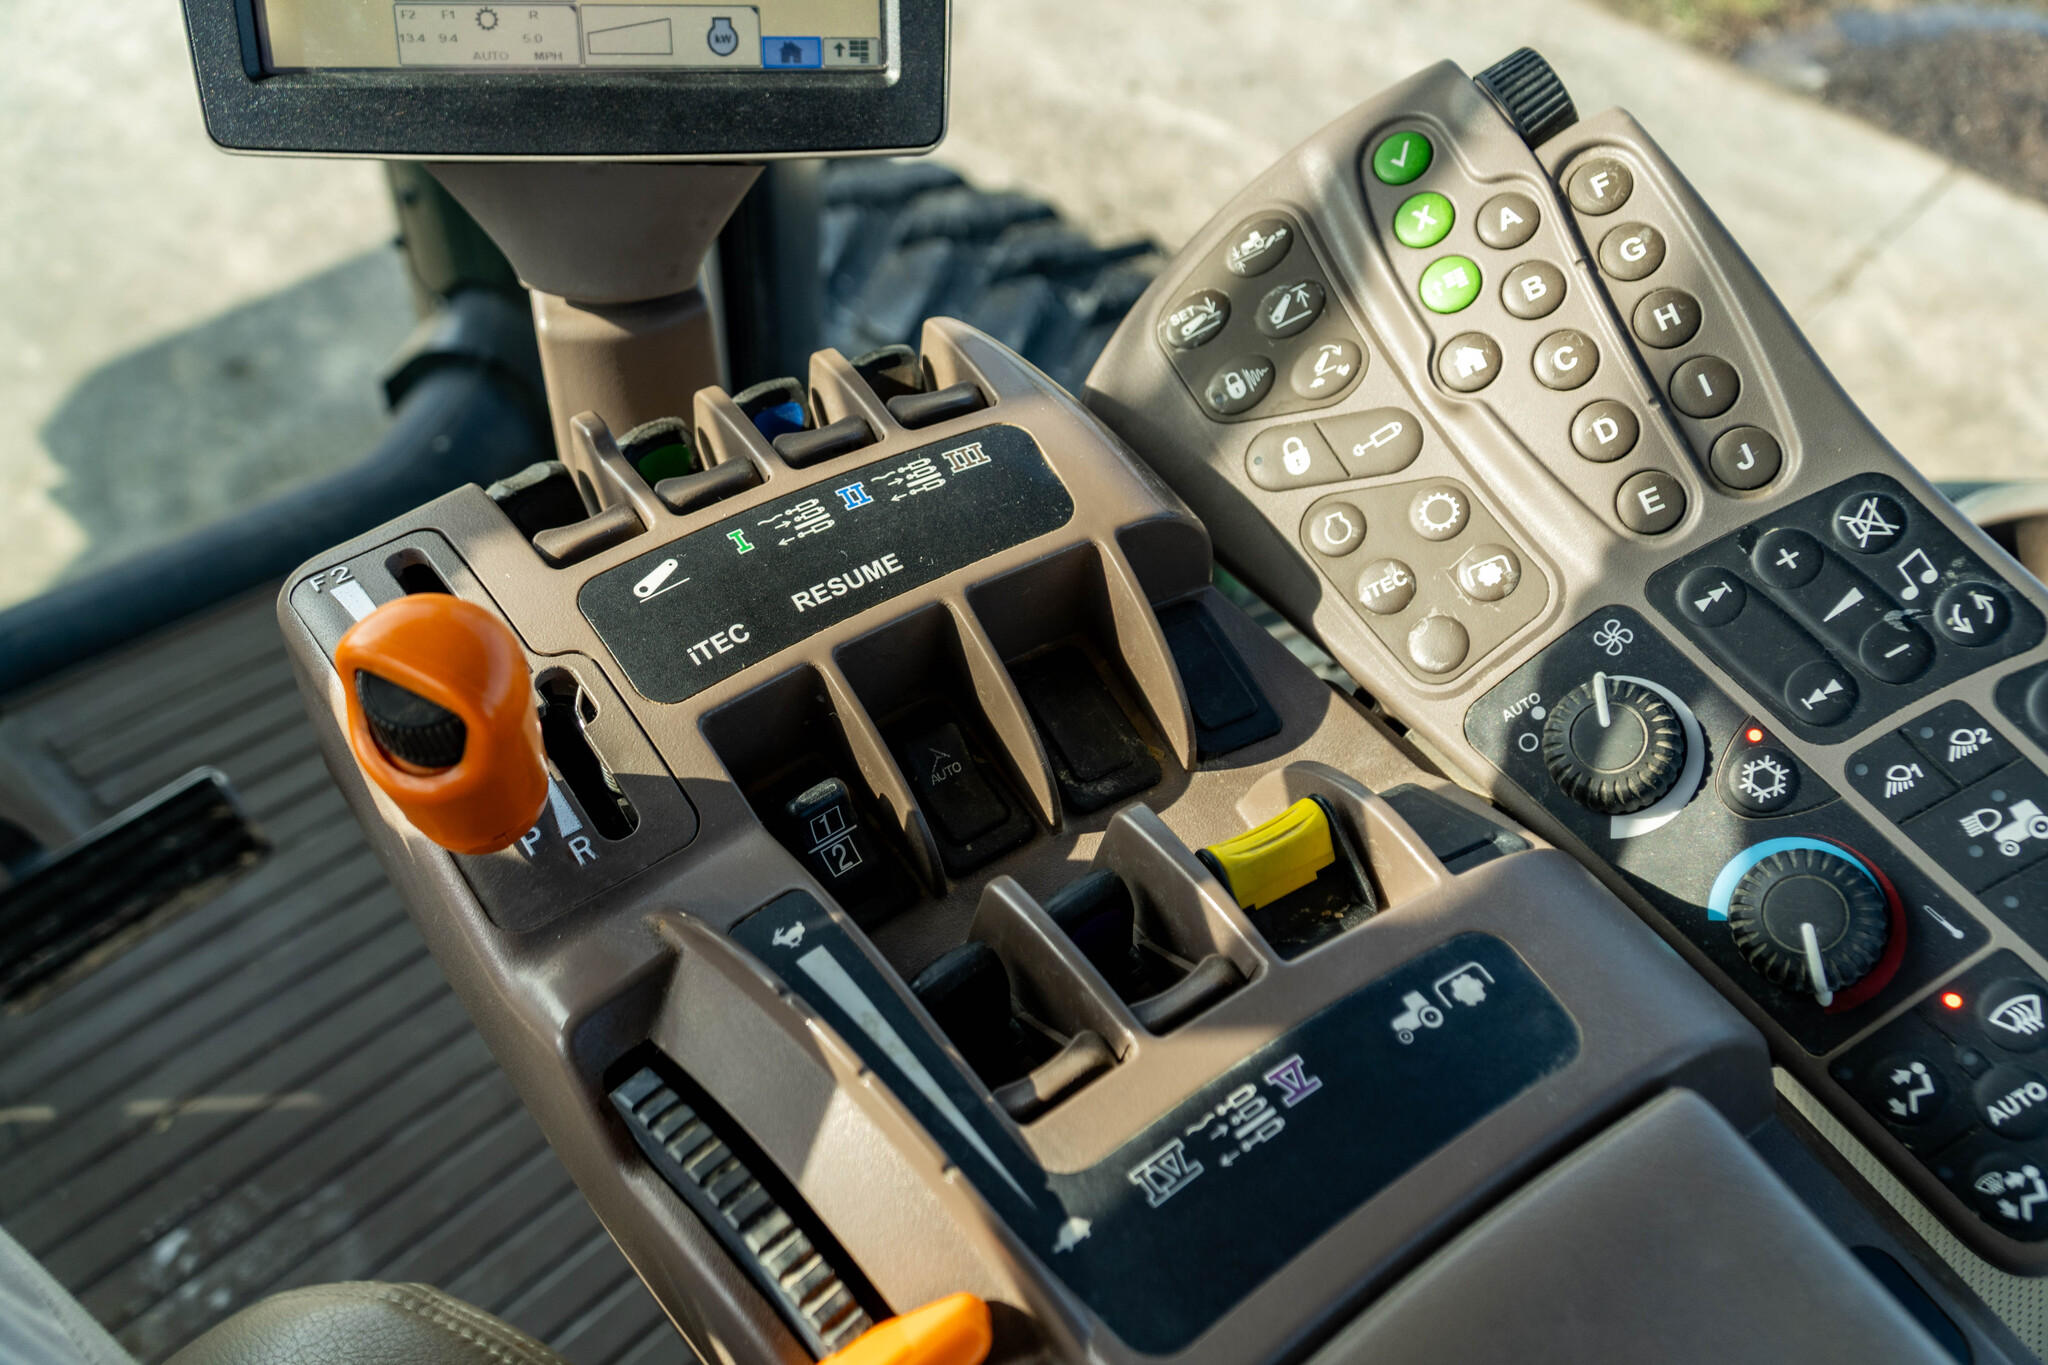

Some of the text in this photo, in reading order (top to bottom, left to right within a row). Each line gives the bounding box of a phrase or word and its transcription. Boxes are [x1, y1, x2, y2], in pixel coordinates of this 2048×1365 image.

[401, 10, 415, 20] F2
[442, 10, 455, 19] F1
[529, 10, 538, 20] R
[473, 51, 509, 61] AUTO
[534, 52, 562, 61] MPH
[1589, 172, 1610, 198] F
[1500, 207, 1523, 232] A
[1620, 237, 1647, 262] G
[1520, 275, 1547, 302] B
[1169, 304, 1196, 327] SET
[1653, 302, 1682, 332] H
[1553, 346, 1578, 372] C
[1592, 417, 1619, 445] D
[1736, 443, 1756, 471] J
[1637, 485, 1666, 516] E
[308, 566, 354, 593] F2
[790, 552, 904, 613] RESUME
[686, 623, 751, 667] iTEC
[1502, 692, 1541, 723] AUTO
[1975, 728, 1993, 744] 2
[930, 761, 963, 786] AUTO
[568, 835, 600, 867] R
[832, 843, 853, 870] 2
[1986, 1081, 2048, 1126] AUTO
